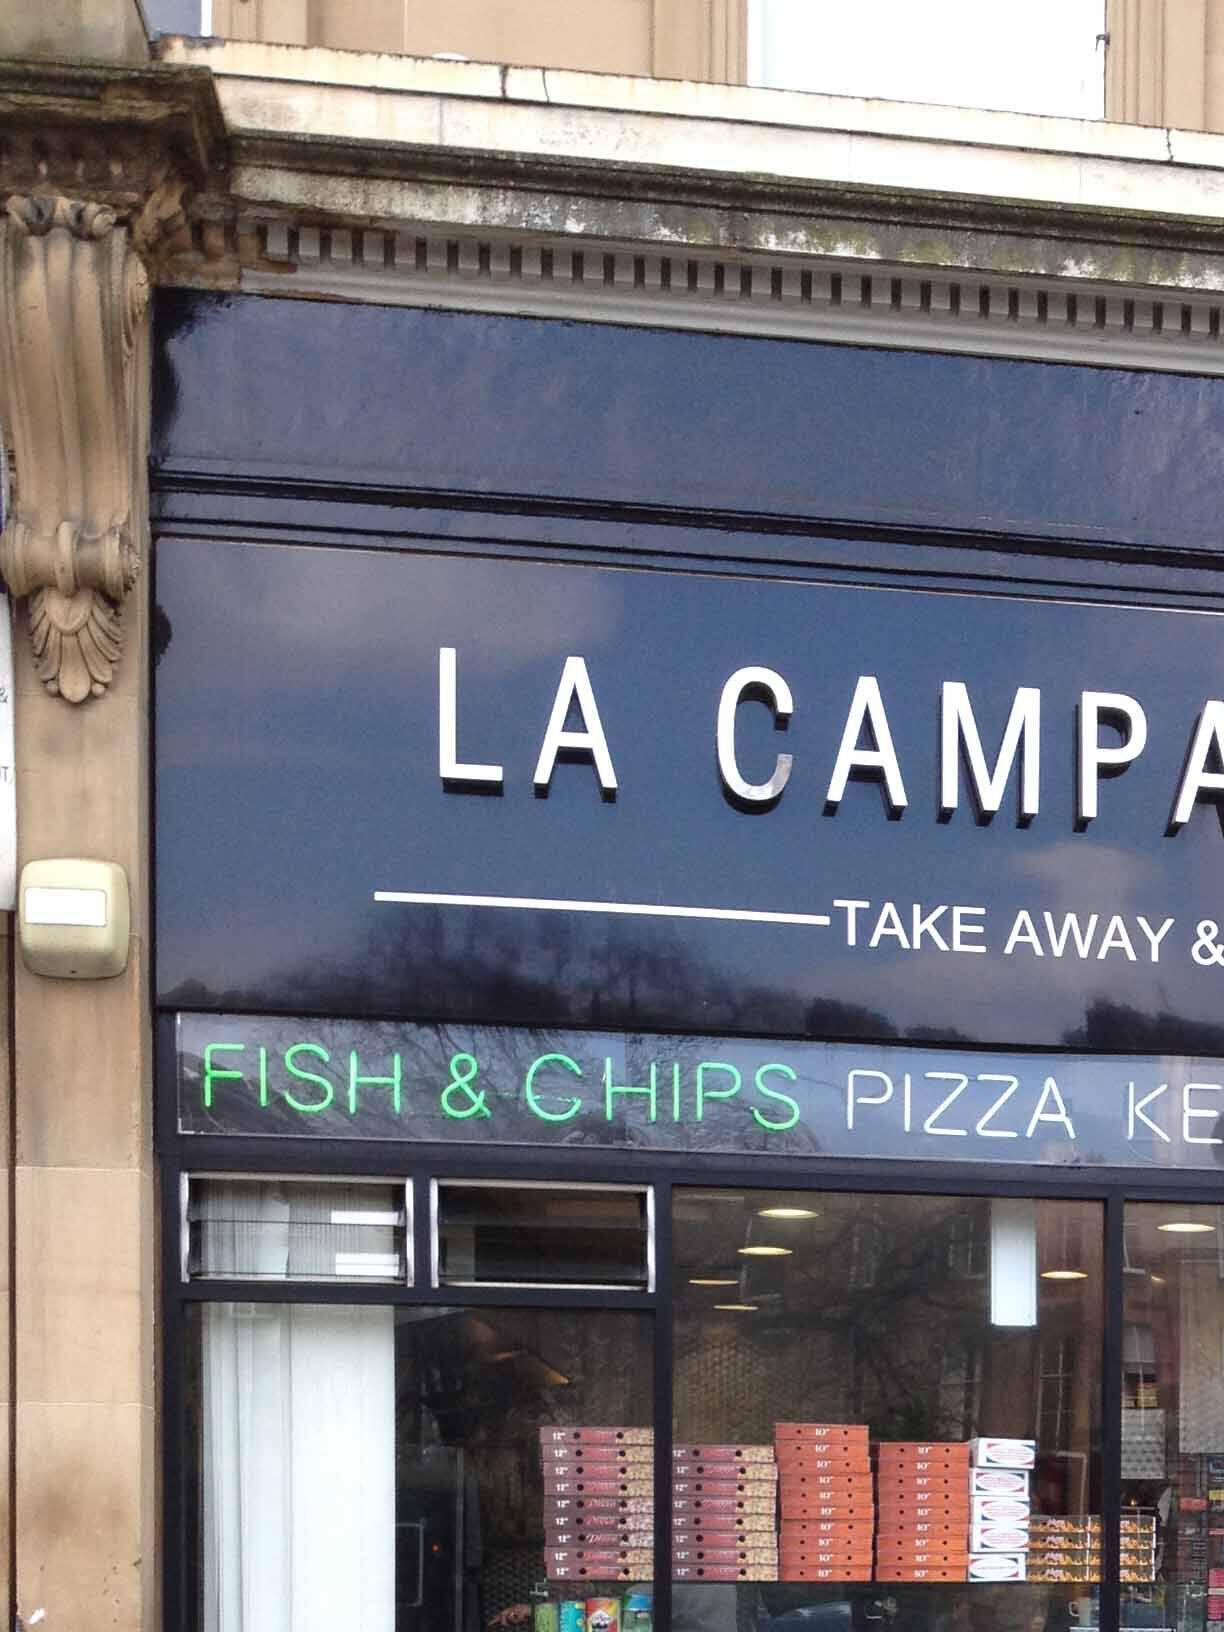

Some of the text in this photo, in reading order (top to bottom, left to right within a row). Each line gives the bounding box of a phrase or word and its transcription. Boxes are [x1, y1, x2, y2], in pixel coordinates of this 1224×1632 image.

[439, 647, 618, 790] LA
[832, 899, 987, 954] TAKE
[1003, 909, 1175, 964] AWAY
[203, 1042, 402, 1115] FISH
[440, 1052, 491, 1121] &
[524, 1052, 801, 1131] CHIPS
[846, 1068, 1076, 1140] PIZZA
